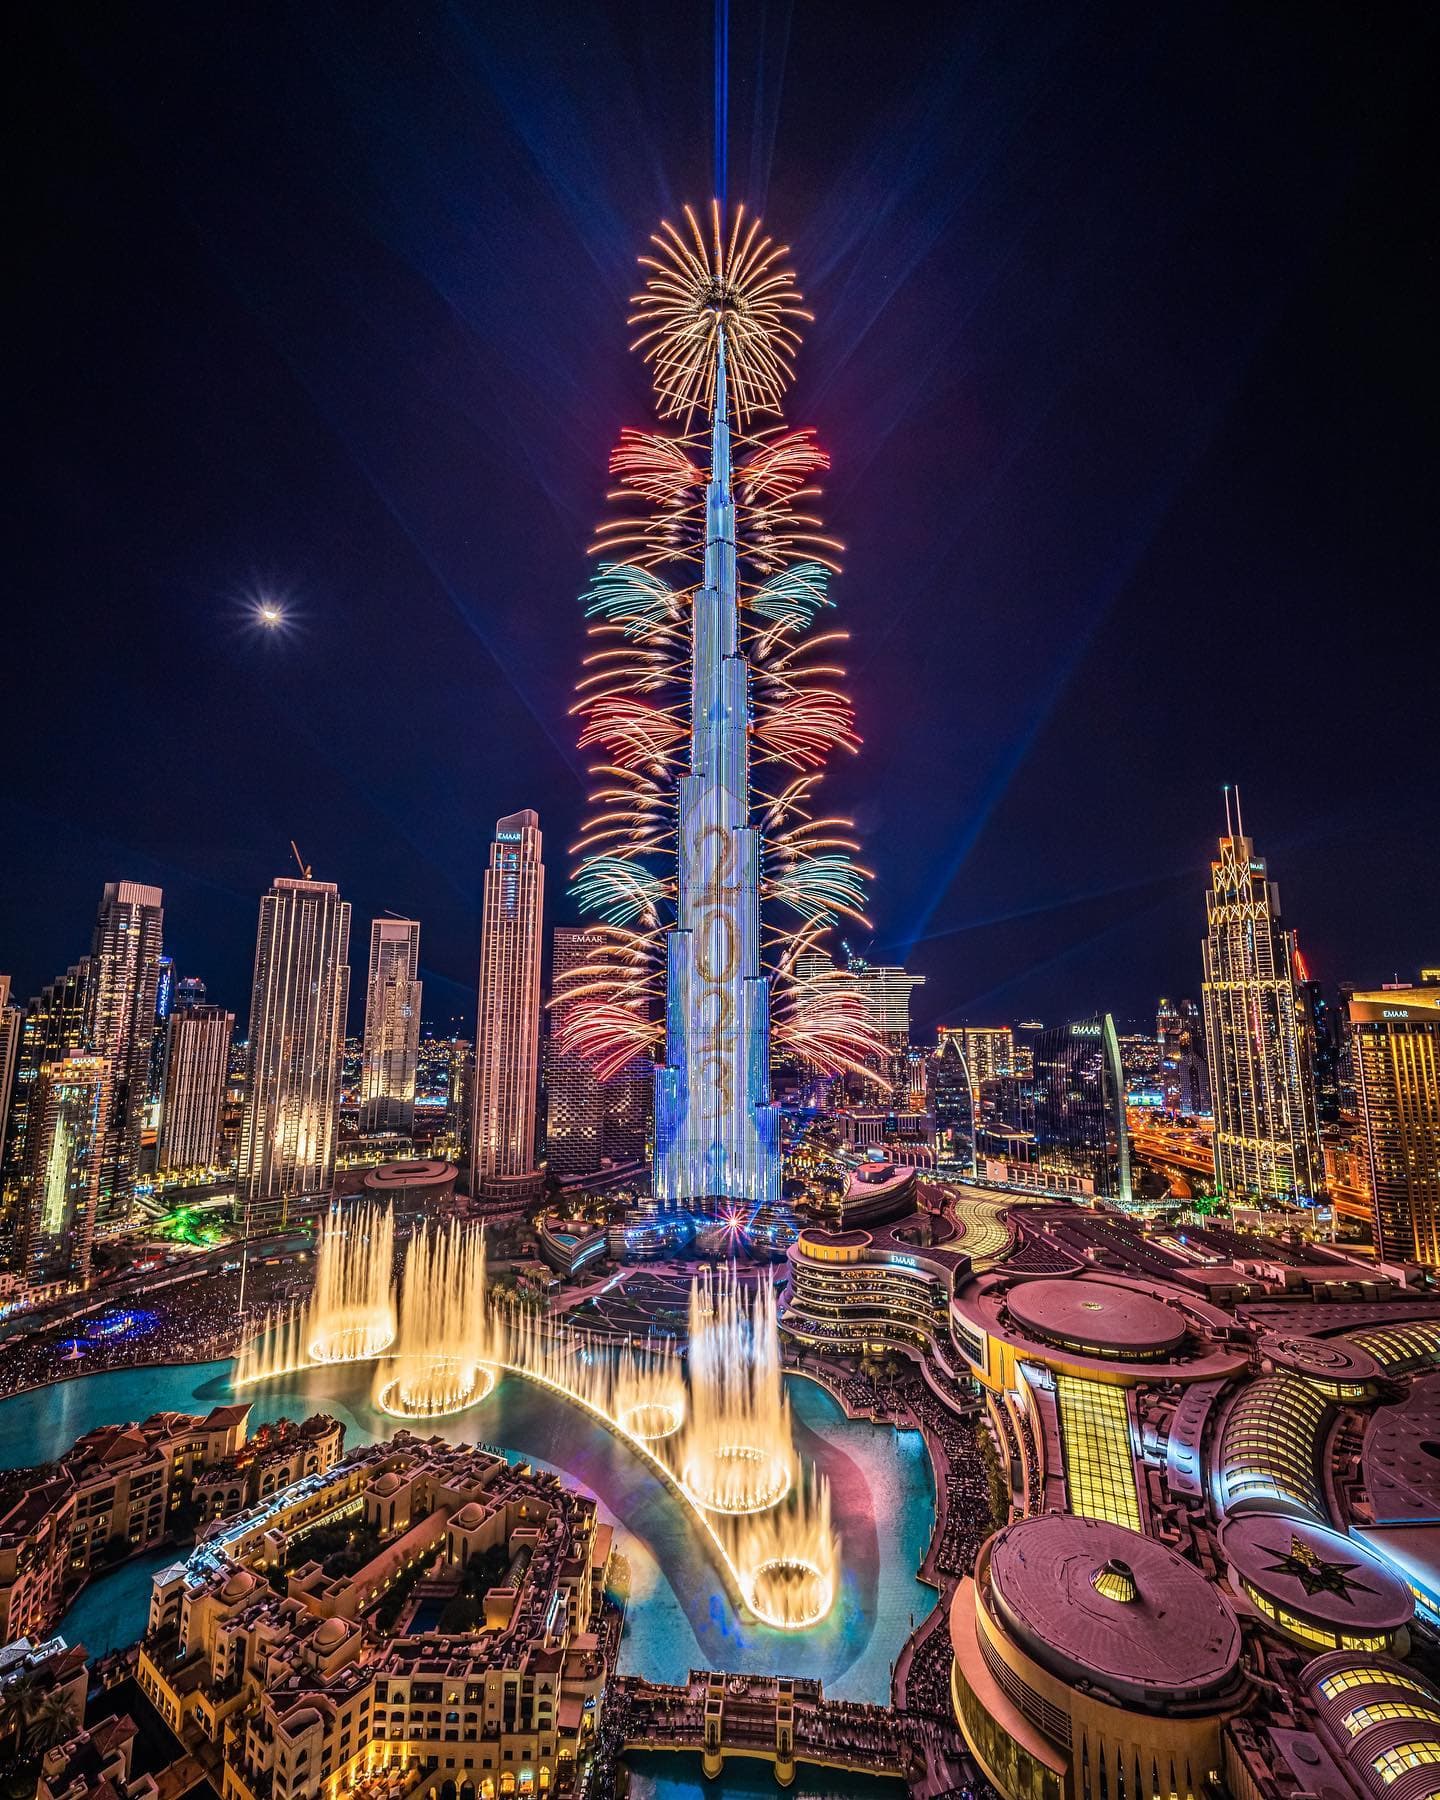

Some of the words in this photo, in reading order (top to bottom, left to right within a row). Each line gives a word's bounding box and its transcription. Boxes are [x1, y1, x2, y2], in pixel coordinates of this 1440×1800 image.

[497, 832, 521, 840] EMAAR
[572, 935, 603, 943] EMAAR
[692, 825, 742, 1120] 2023
[1383, 1010, 1409, 1018] EMAAR
[1072, 1026, 1101, 1035] EMAAR
[891, 1255, 916, 1266] EMAAR
